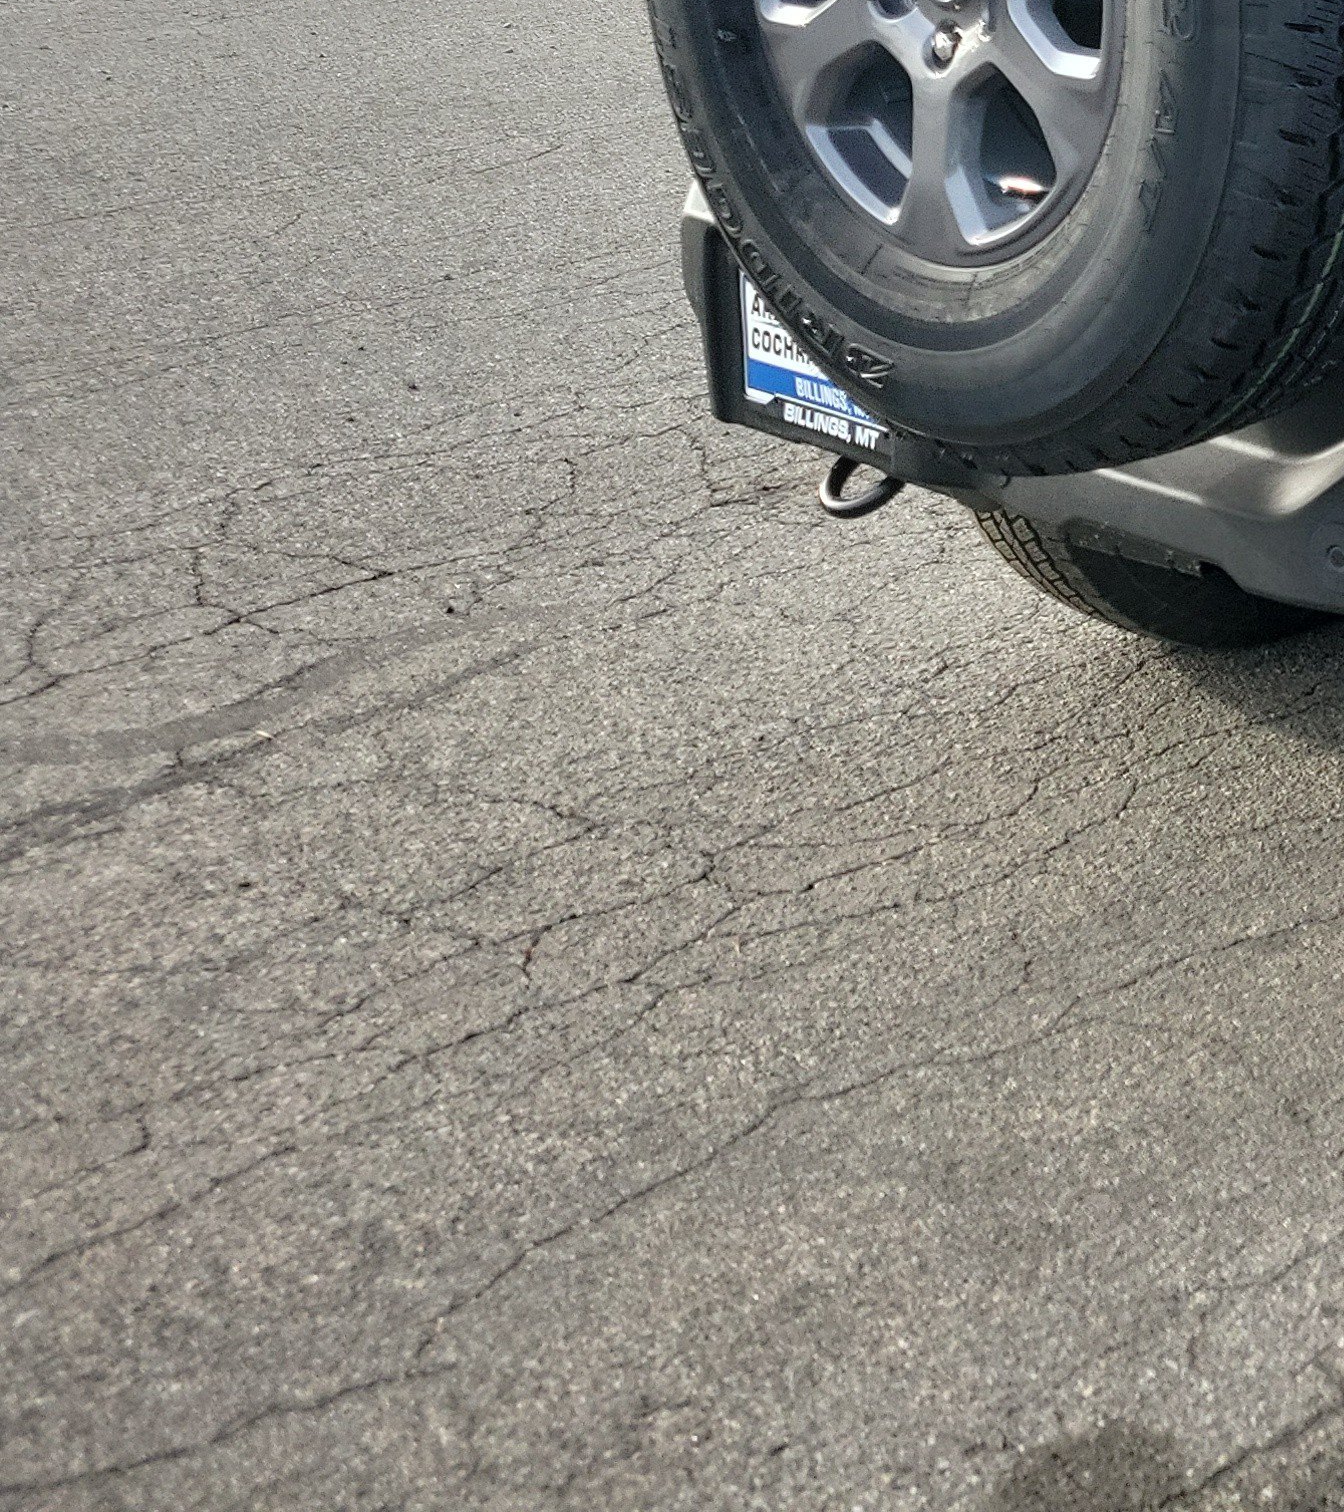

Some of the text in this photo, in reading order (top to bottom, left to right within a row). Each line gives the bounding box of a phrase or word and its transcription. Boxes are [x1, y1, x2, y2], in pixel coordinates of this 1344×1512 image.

[794, 376, 851, 416] BILLINGS,
[783, 403, 880, 451] BILLINGS, MT
